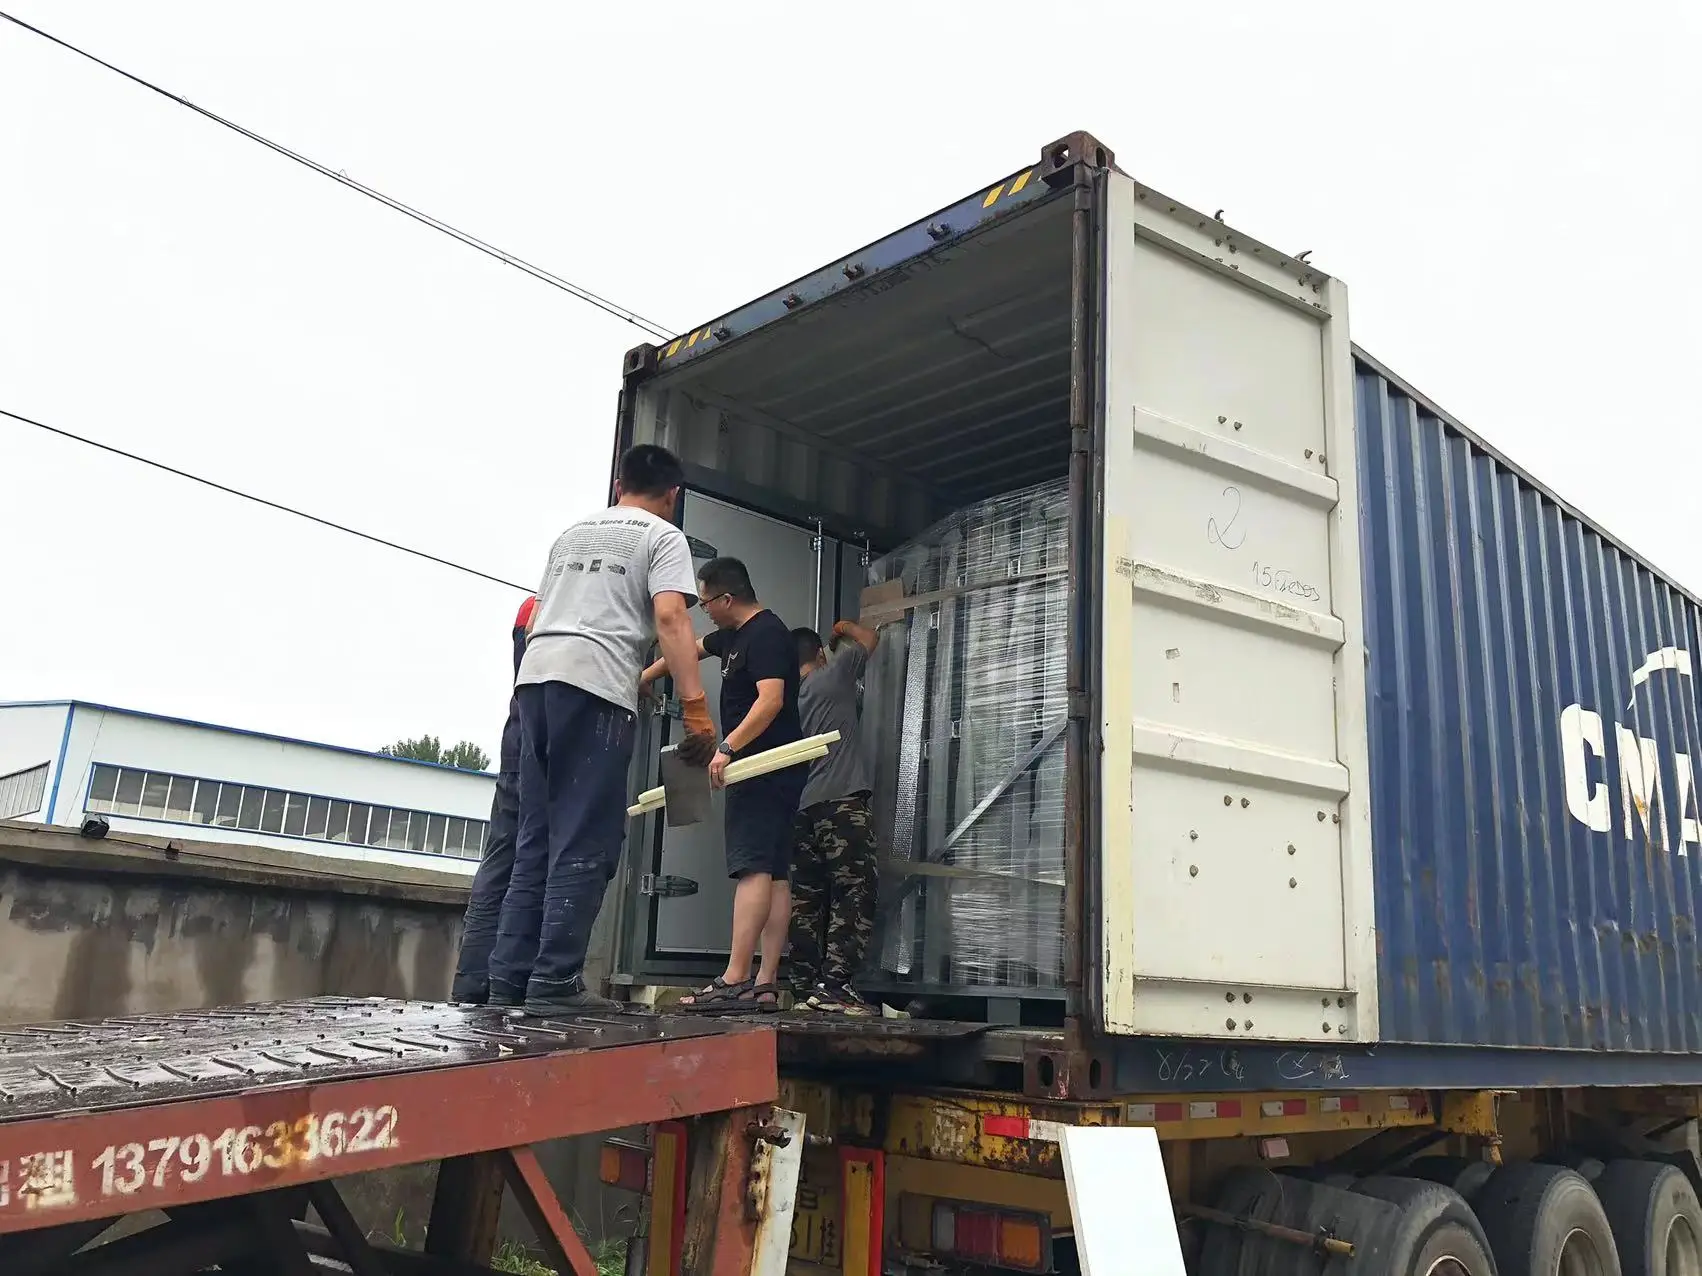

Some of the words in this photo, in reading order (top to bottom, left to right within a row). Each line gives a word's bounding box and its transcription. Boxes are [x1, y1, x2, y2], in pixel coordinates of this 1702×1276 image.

[625, 519, 651, 528] 1966
[1208, 486, 1247, 549] 2
[91, 1104, 399, 1197] 13791633622
